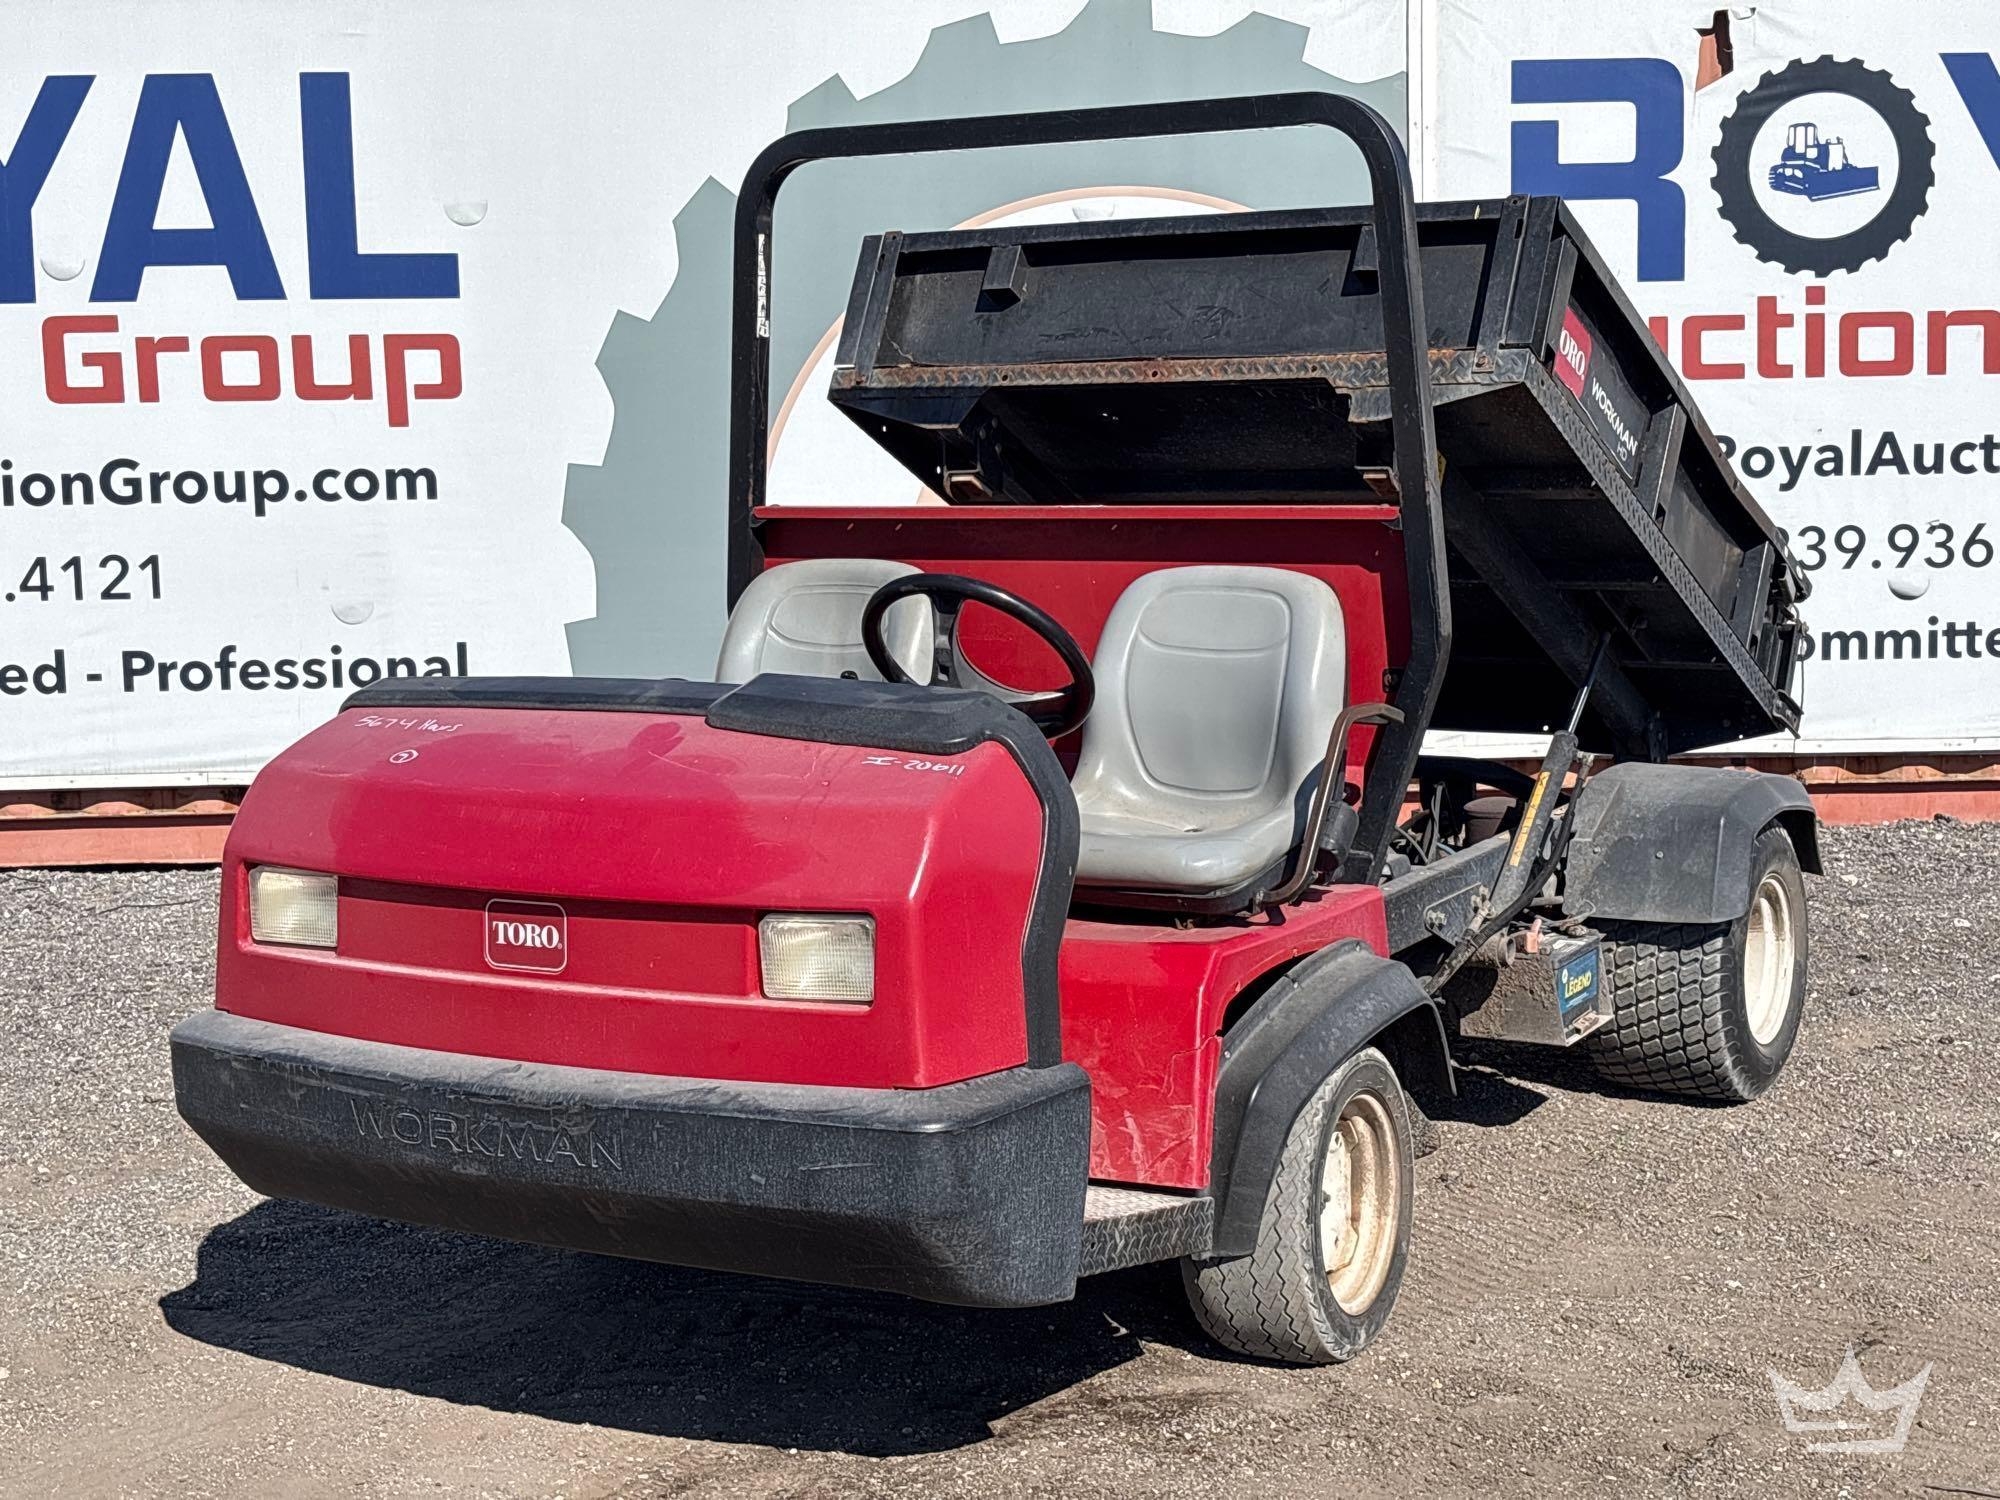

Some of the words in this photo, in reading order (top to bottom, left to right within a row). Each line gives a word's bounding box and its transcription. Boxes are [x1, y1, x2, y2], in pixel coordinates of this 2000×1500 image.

[1559, 328, 1586, 381] ORO
[1649, 286, 2000, 380] ction
[42, 315, 462, 427] Group
[1592, 377, 1638, 457] WORKMAN
[0, 458, 438, 517] ionGroup.com
[5, 554, 162, 602] .4121
[122, 642, 468, 692] Professional
[355, 715, 417, 730] 5674
[493, 921, 560, 949] TORO
[350, 1098, 623, 1171] WORKMAN
